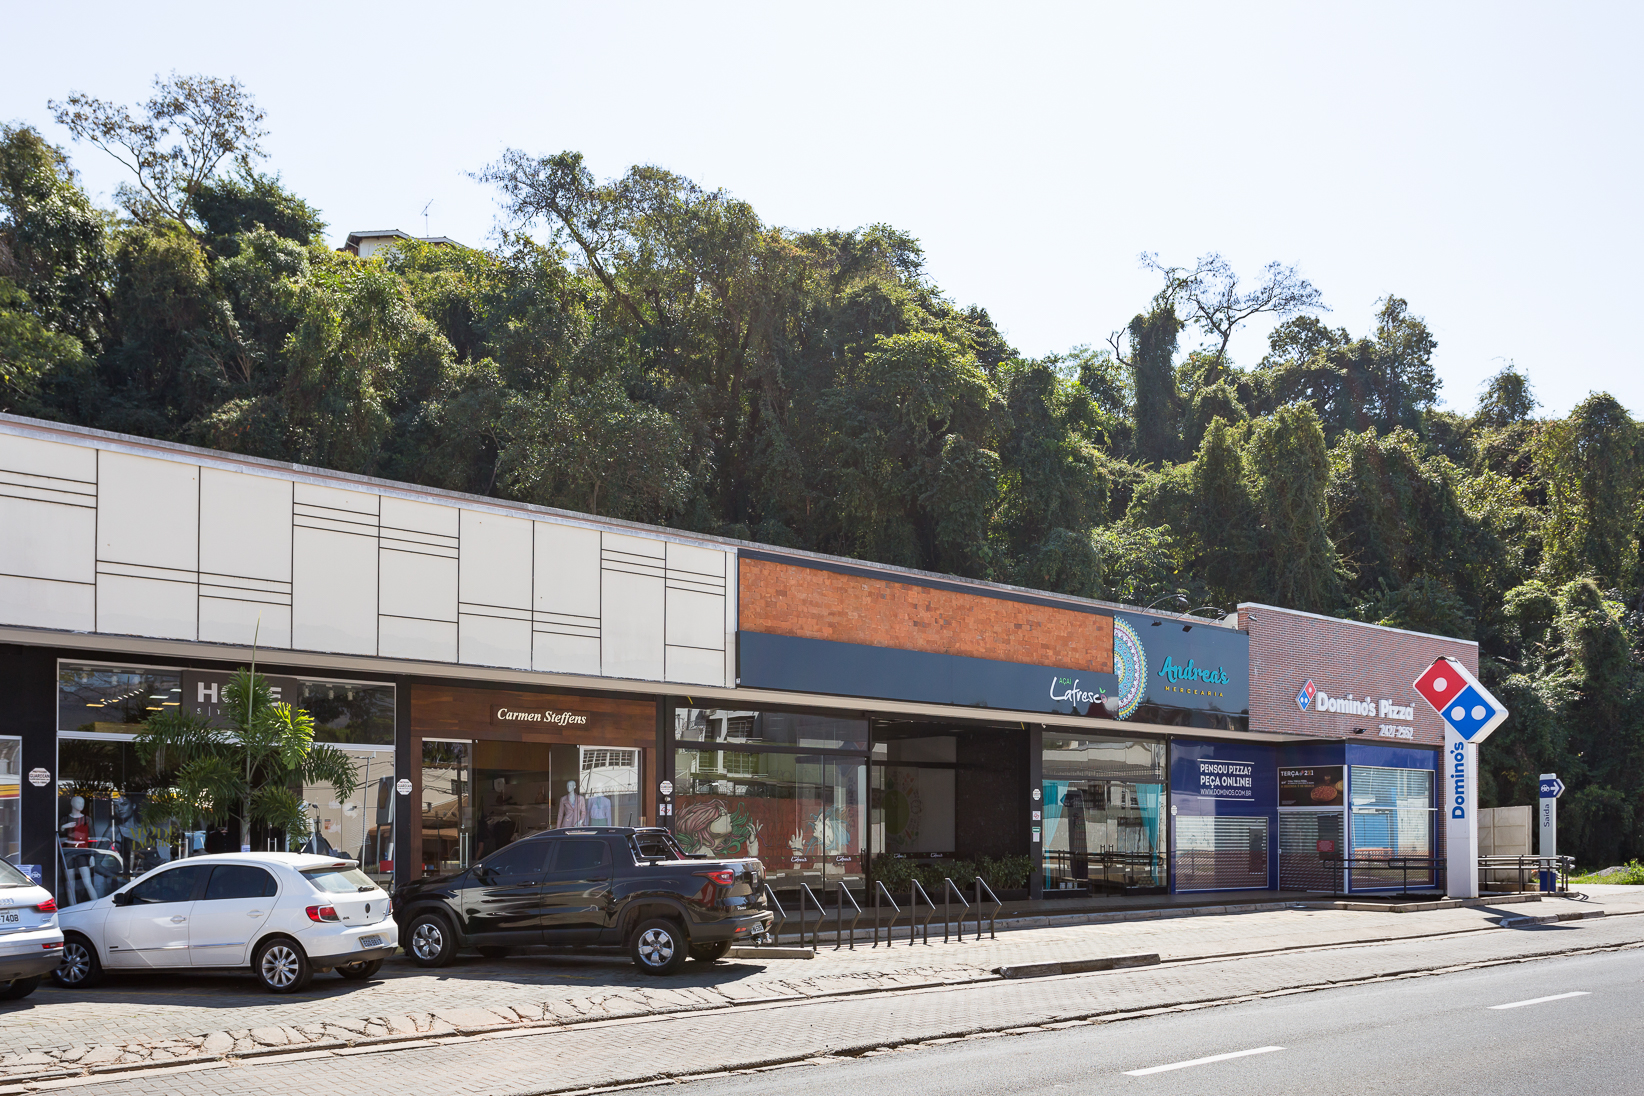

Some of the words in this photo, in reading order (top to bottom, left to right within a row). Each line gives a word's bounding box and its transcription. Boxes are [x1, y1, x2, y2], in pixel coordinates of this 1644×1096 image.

[1157, 655, 1229, 684] Andrea's
[1164, 685, 1223, 697] MERCEARIA
[1315, 691, 1376, 717] Domino's
[1378, 699, 1415, 720] Pizza
[497, 708, 541, 721] Carmen
[543, 710, 587, 726] Steffens
[1200, 764, 1228, 774] PENSOU
[1228, 766, 1252, 775] PIZZA?
[1200, 775, 1221, 788] PEÇA
[1221, 776, 1252, 788] ONLINE!
[1450, 741, 1466, 819] Domino's
[1200, 789, 1252, 797] WWW.DOMINOS.COM.BR
